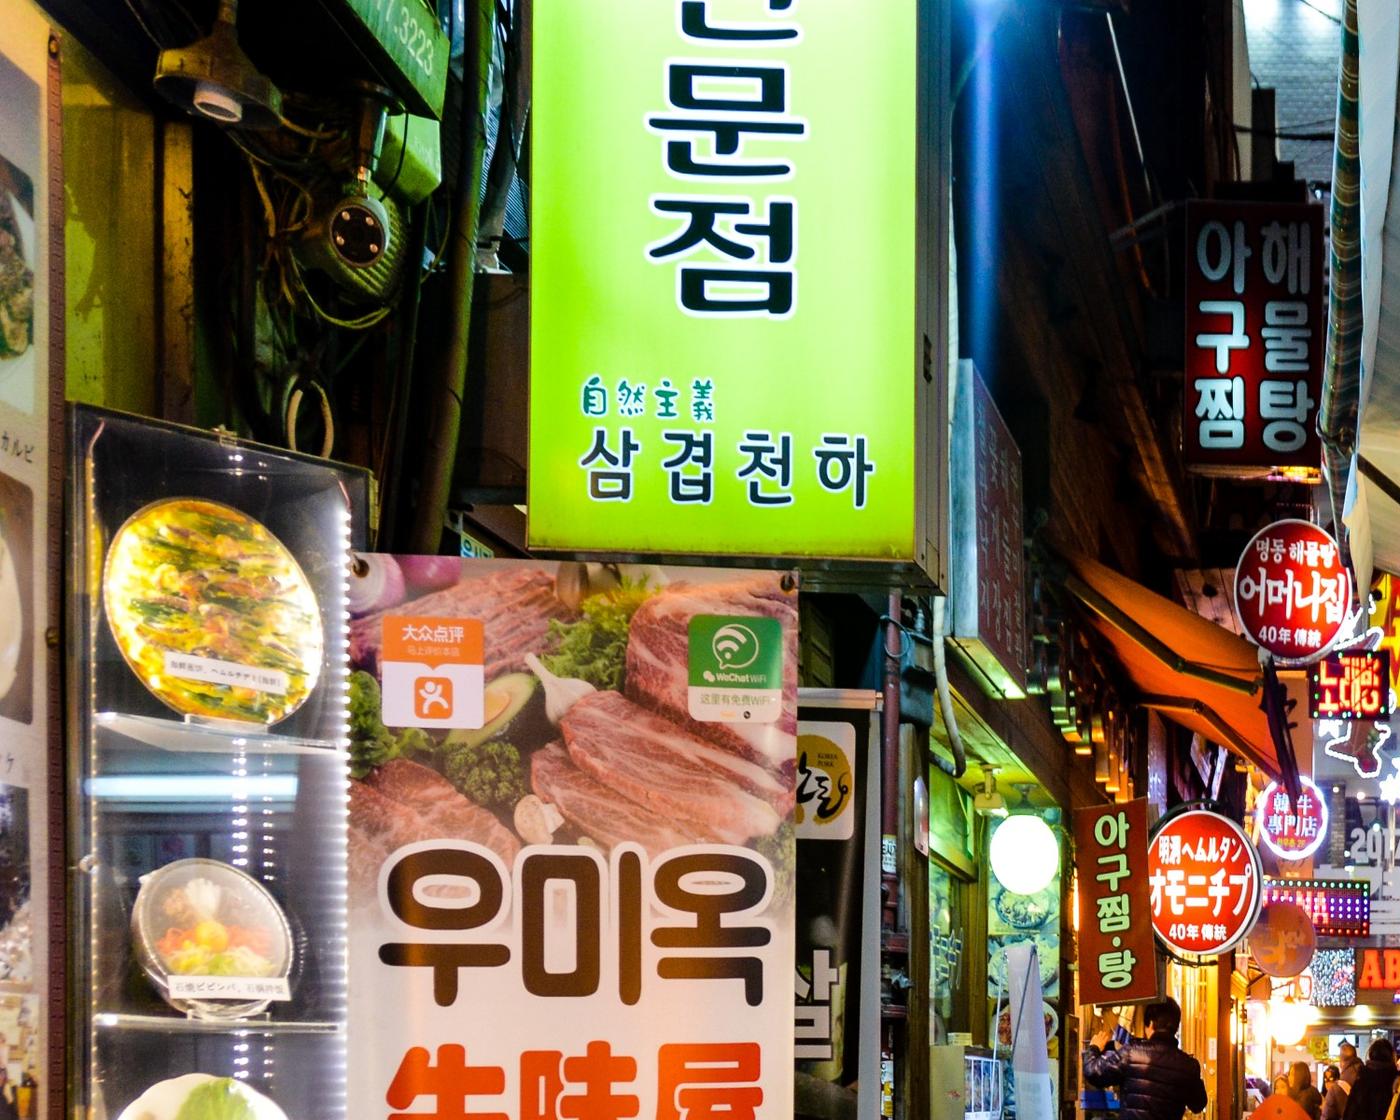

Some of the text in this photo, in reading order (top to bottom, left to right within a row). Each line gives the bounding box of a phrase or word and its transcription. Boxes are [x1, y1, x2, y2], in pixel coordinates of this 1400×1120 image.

[1194, 220, 1252, 450] 아구찜
[1259, 220, 1314, 453] 해물탕
[582, 376, 716, 423] 自然主義
[578, 429, 877, 508] 삼겹천하
[1255, 540, 1286, 564] 명동
[1239, 567, 1346, 623] 어머니집
[402, 624, 464, 643] 大众点评
[1258, 626, 1291, 644] 40年
[715, 670, 751, 684] WeChat
[378, 848, 771, 1007] 우미옥
[1168, 924, 1200, 939] 40年
